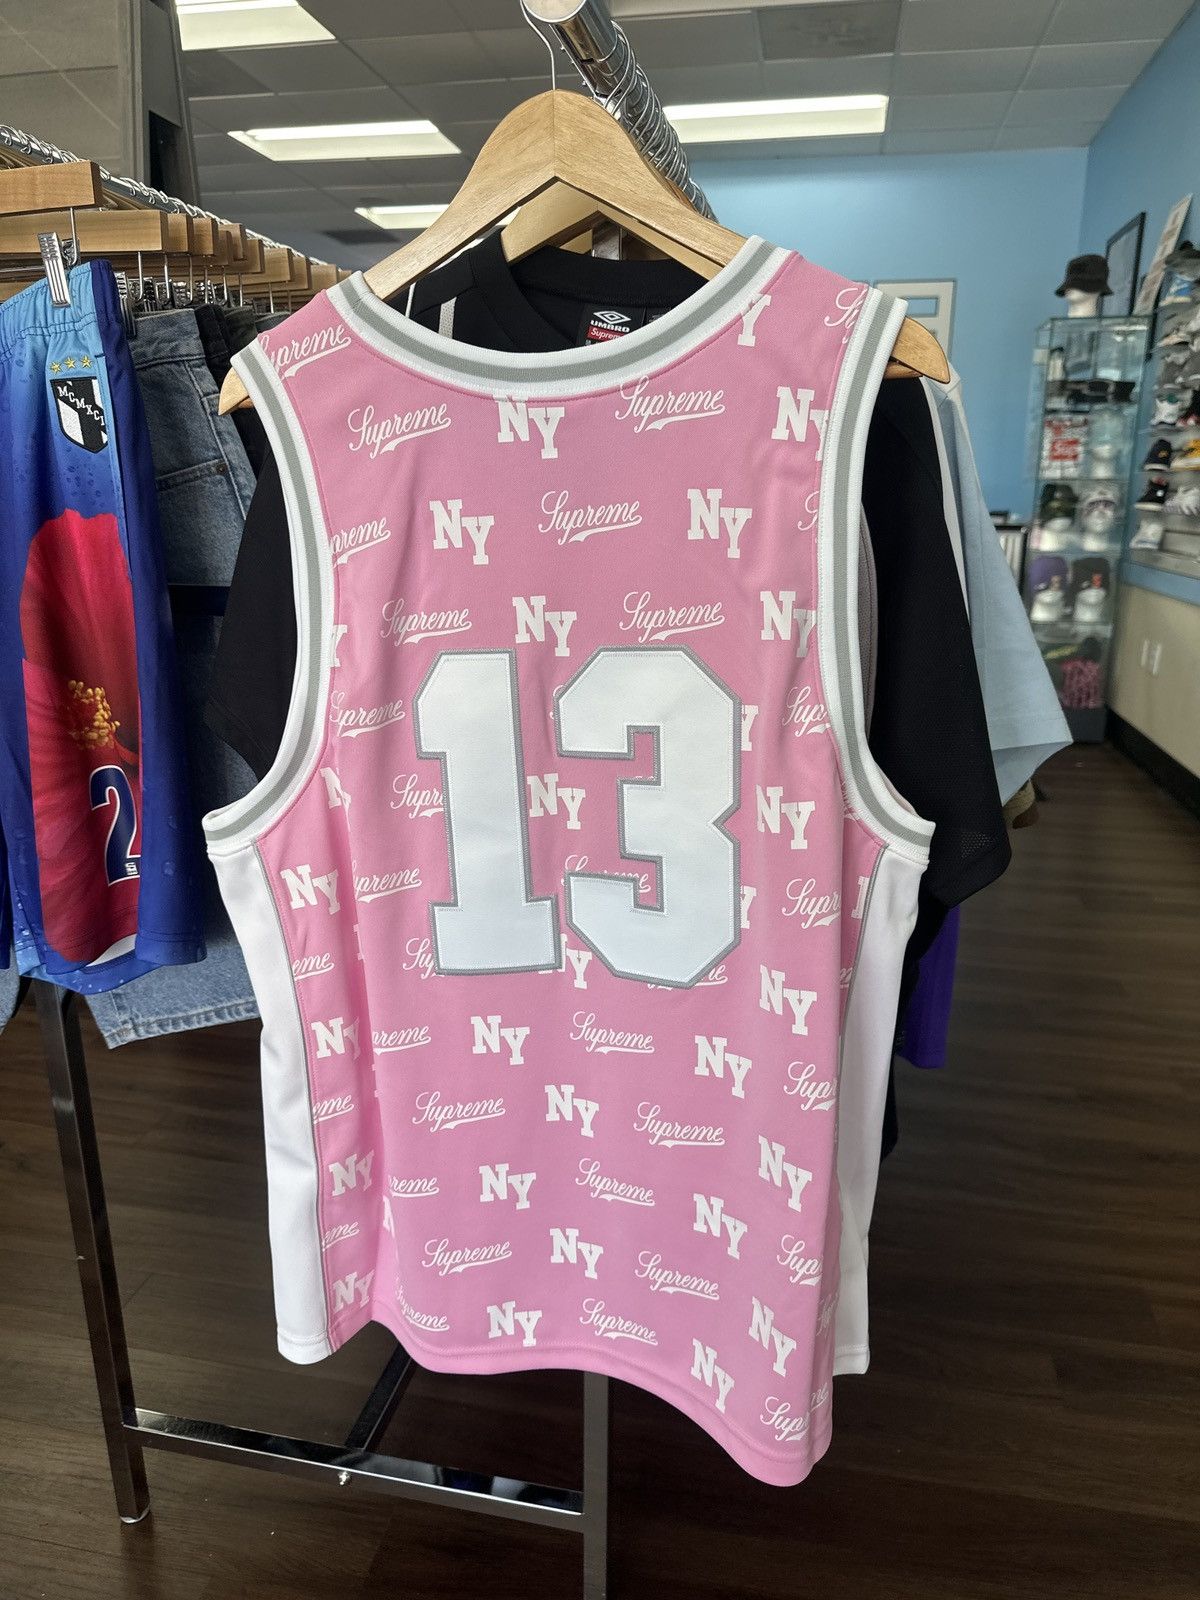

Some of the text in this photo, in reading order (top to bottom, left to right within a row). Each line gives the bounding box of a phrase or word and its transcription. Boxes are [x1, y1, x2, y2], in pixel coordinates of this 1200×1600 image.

[590, 320, 630, 332] UMBRO
[590, 328, 622, 339] Suprem
[737, 295, 771, 347] Y
[493, 394, 565, 459] NY
[615, 376, 725, 433] Supreme
[348, 403, 451, 459] Supreme
[329, 517, 391, 567] preme
[429, 499, 494, 565] NY
[538, 490, 642, 545] Supreme
[687, 488, 752, 558] NY
[381, 598, 472, 646] Supreme
[512, 595, 577, 656] NY
[619, 591, 725, 642] Supreme
[760, 590, 817, 658] NY
[329, 691, 405, 737] Supreme
[412, 647, 742, 989] 13
[527, 773, 585, 829] NY
[756, 784, 815, 849] NY
[281, 864, 341, 914] NY
[352, 857, 422, 903] upreme
[759, 964, 817, 1035] NY
[311, 1017, 360, 1060] NY
[471, 1015, 530, 1065] NY
[570, 1011, 655, 1054] Supreme
[694, 1035, 752, 1099] NY
[412, 1092, 506, 1132] Supreme
[545, 1084, 600, 1137] NY
[633, 1102, 725, 1148] Supreme
[329, 1150, 374, 1196] NY
[479, 1163, 536, 1209] NY
[575, 1158, 655, 1206] Supreme
[758, 1134, 812, 1212] NY
[693, 1193, 747, 1260] NY
[421, 1238, 513, 1276] Supreme
[550, 1228, 604, 1279] NY
[635, 1251, 720, 1300] Supreme
[332, 1269, 375, 1313] NY
[487, 1301, 542, 1346] NY
[579, 1298, 658, 1346] Supreme
[749, 1296, 796, 1377] NY
[691, 1338, 735, 1413] NY
